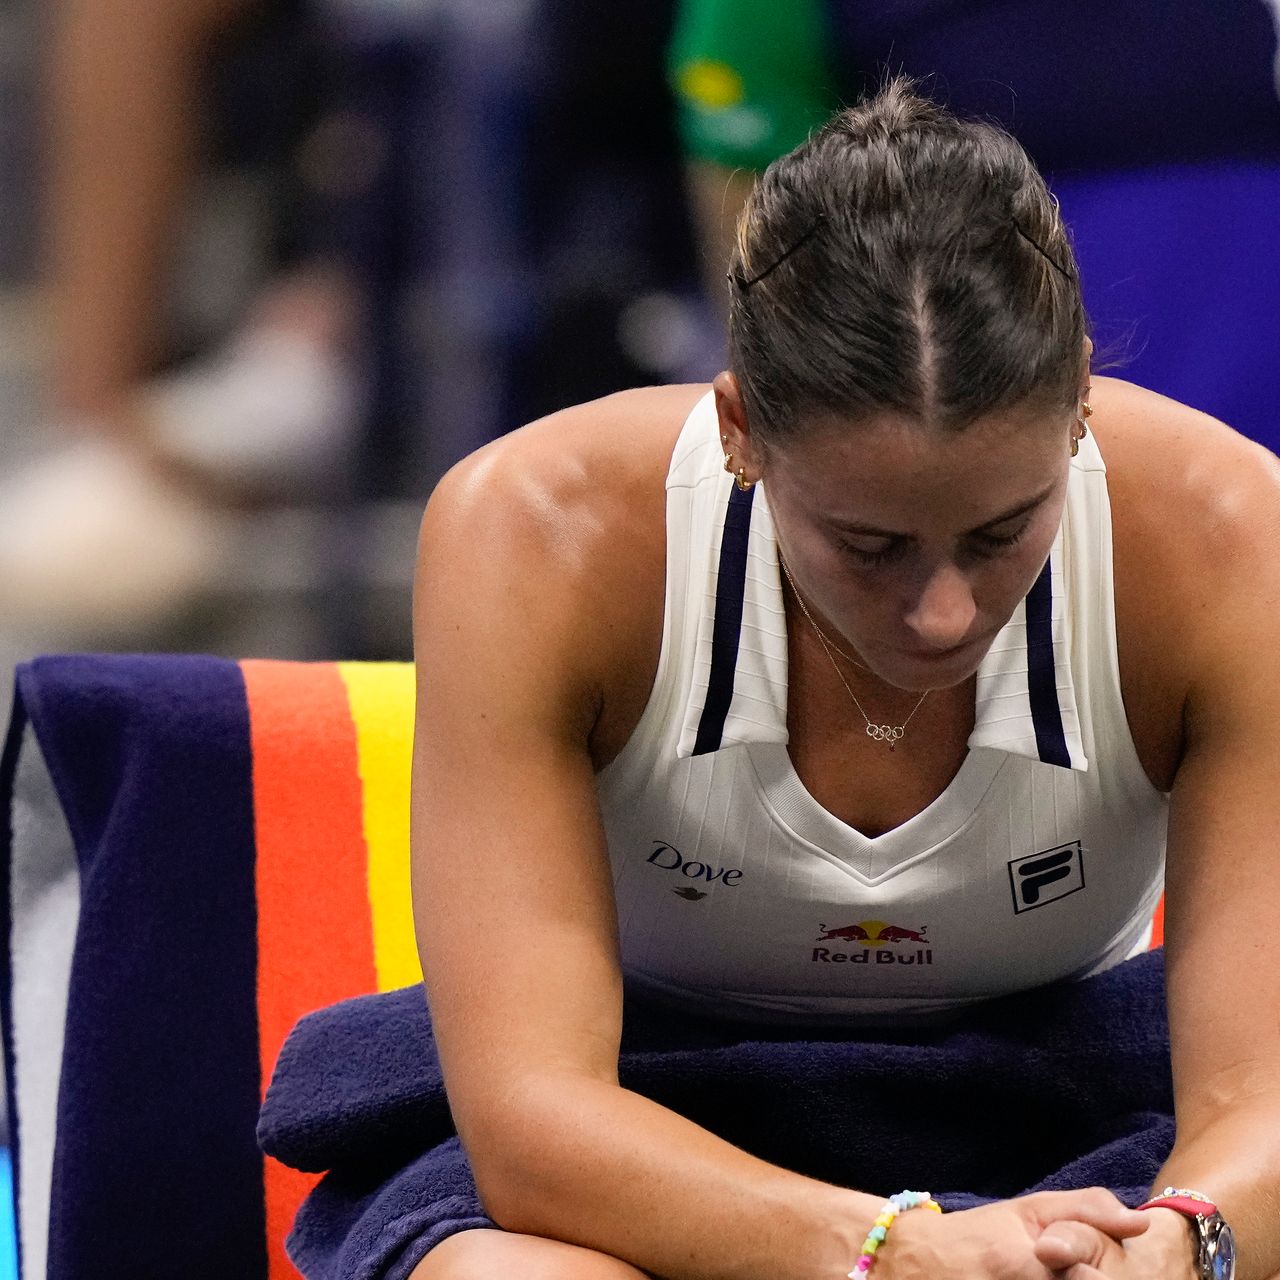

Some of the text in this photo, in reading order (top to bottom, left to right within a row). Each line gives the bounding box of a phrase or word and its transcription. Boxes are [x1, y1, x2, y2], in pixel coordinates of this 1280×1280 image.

[645, 840, 743, 887] Dove
[811, 947, 933, 965] Red Bull
